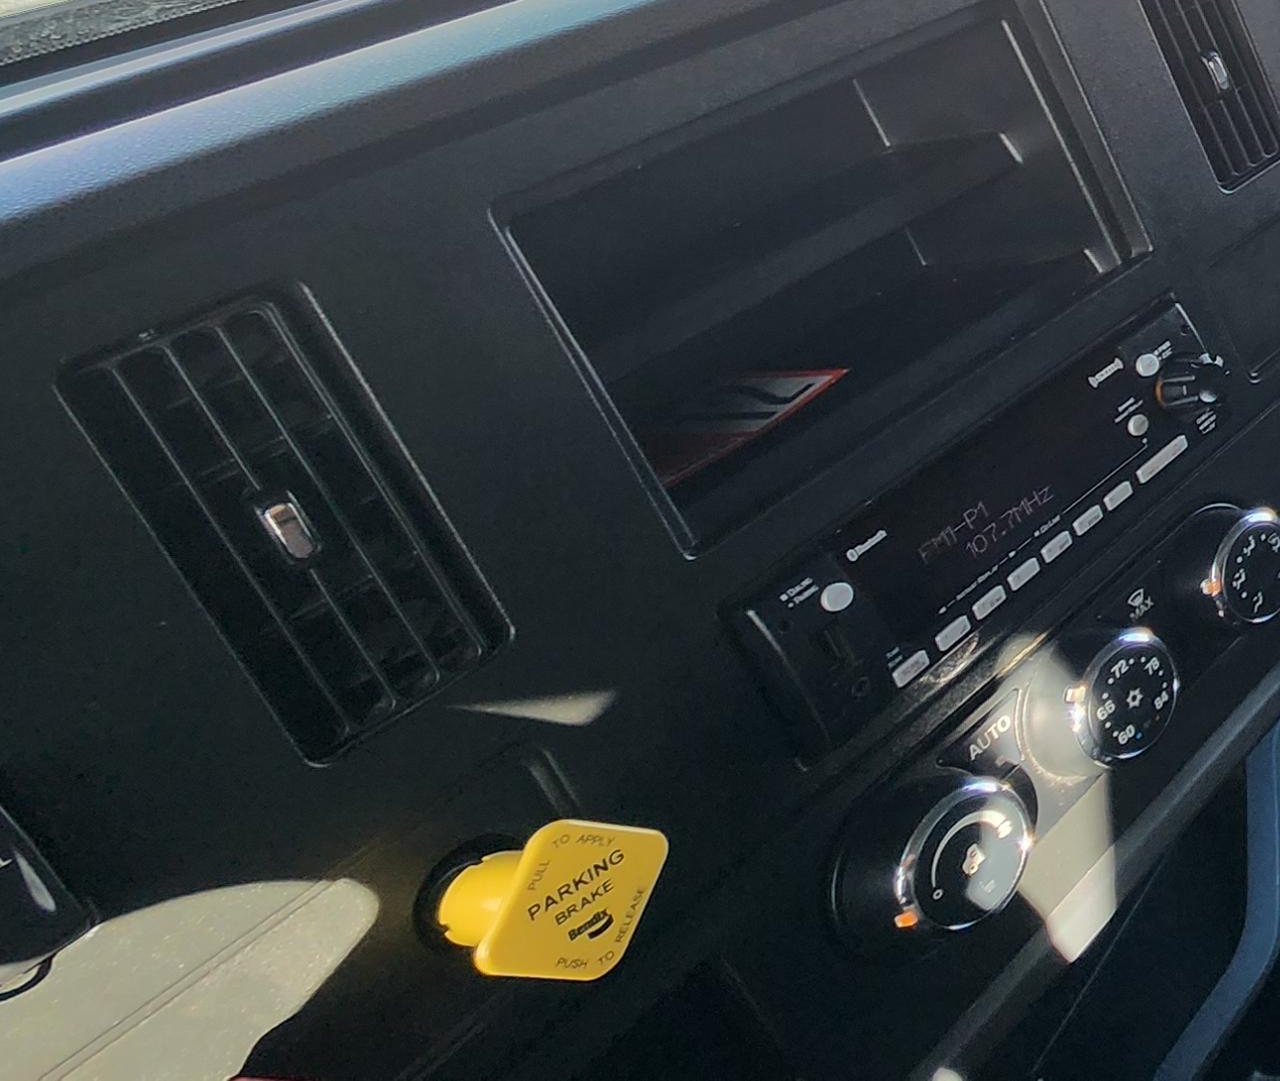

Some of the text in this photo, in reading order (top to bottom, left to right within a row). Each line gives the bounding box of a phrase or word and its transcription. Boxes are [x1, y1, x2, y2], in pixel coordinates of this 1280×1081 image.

[965, 485, 1054, 558] 107.7MHz
[1129, 595, 1155, 619] MAX
[1110, 659, 1129, 679] 72
[1144, 657, 1160, 675] 78
[1096, 700, 1116, 720] 66
[1153, 691, 1170, 710] 84
[969, 714, 1011, 761] AUTO
[1117, 724, 1136, 745] 60
[528, 834, 616, 891] PULL TO APPLY
[527, 848, 625, 921] PARKING
[554, 878, 615, 926] BRAKE
[554, 888, 645, 969] PUSH TO RELEASE
[567, 907, 610, 942] Bendix
